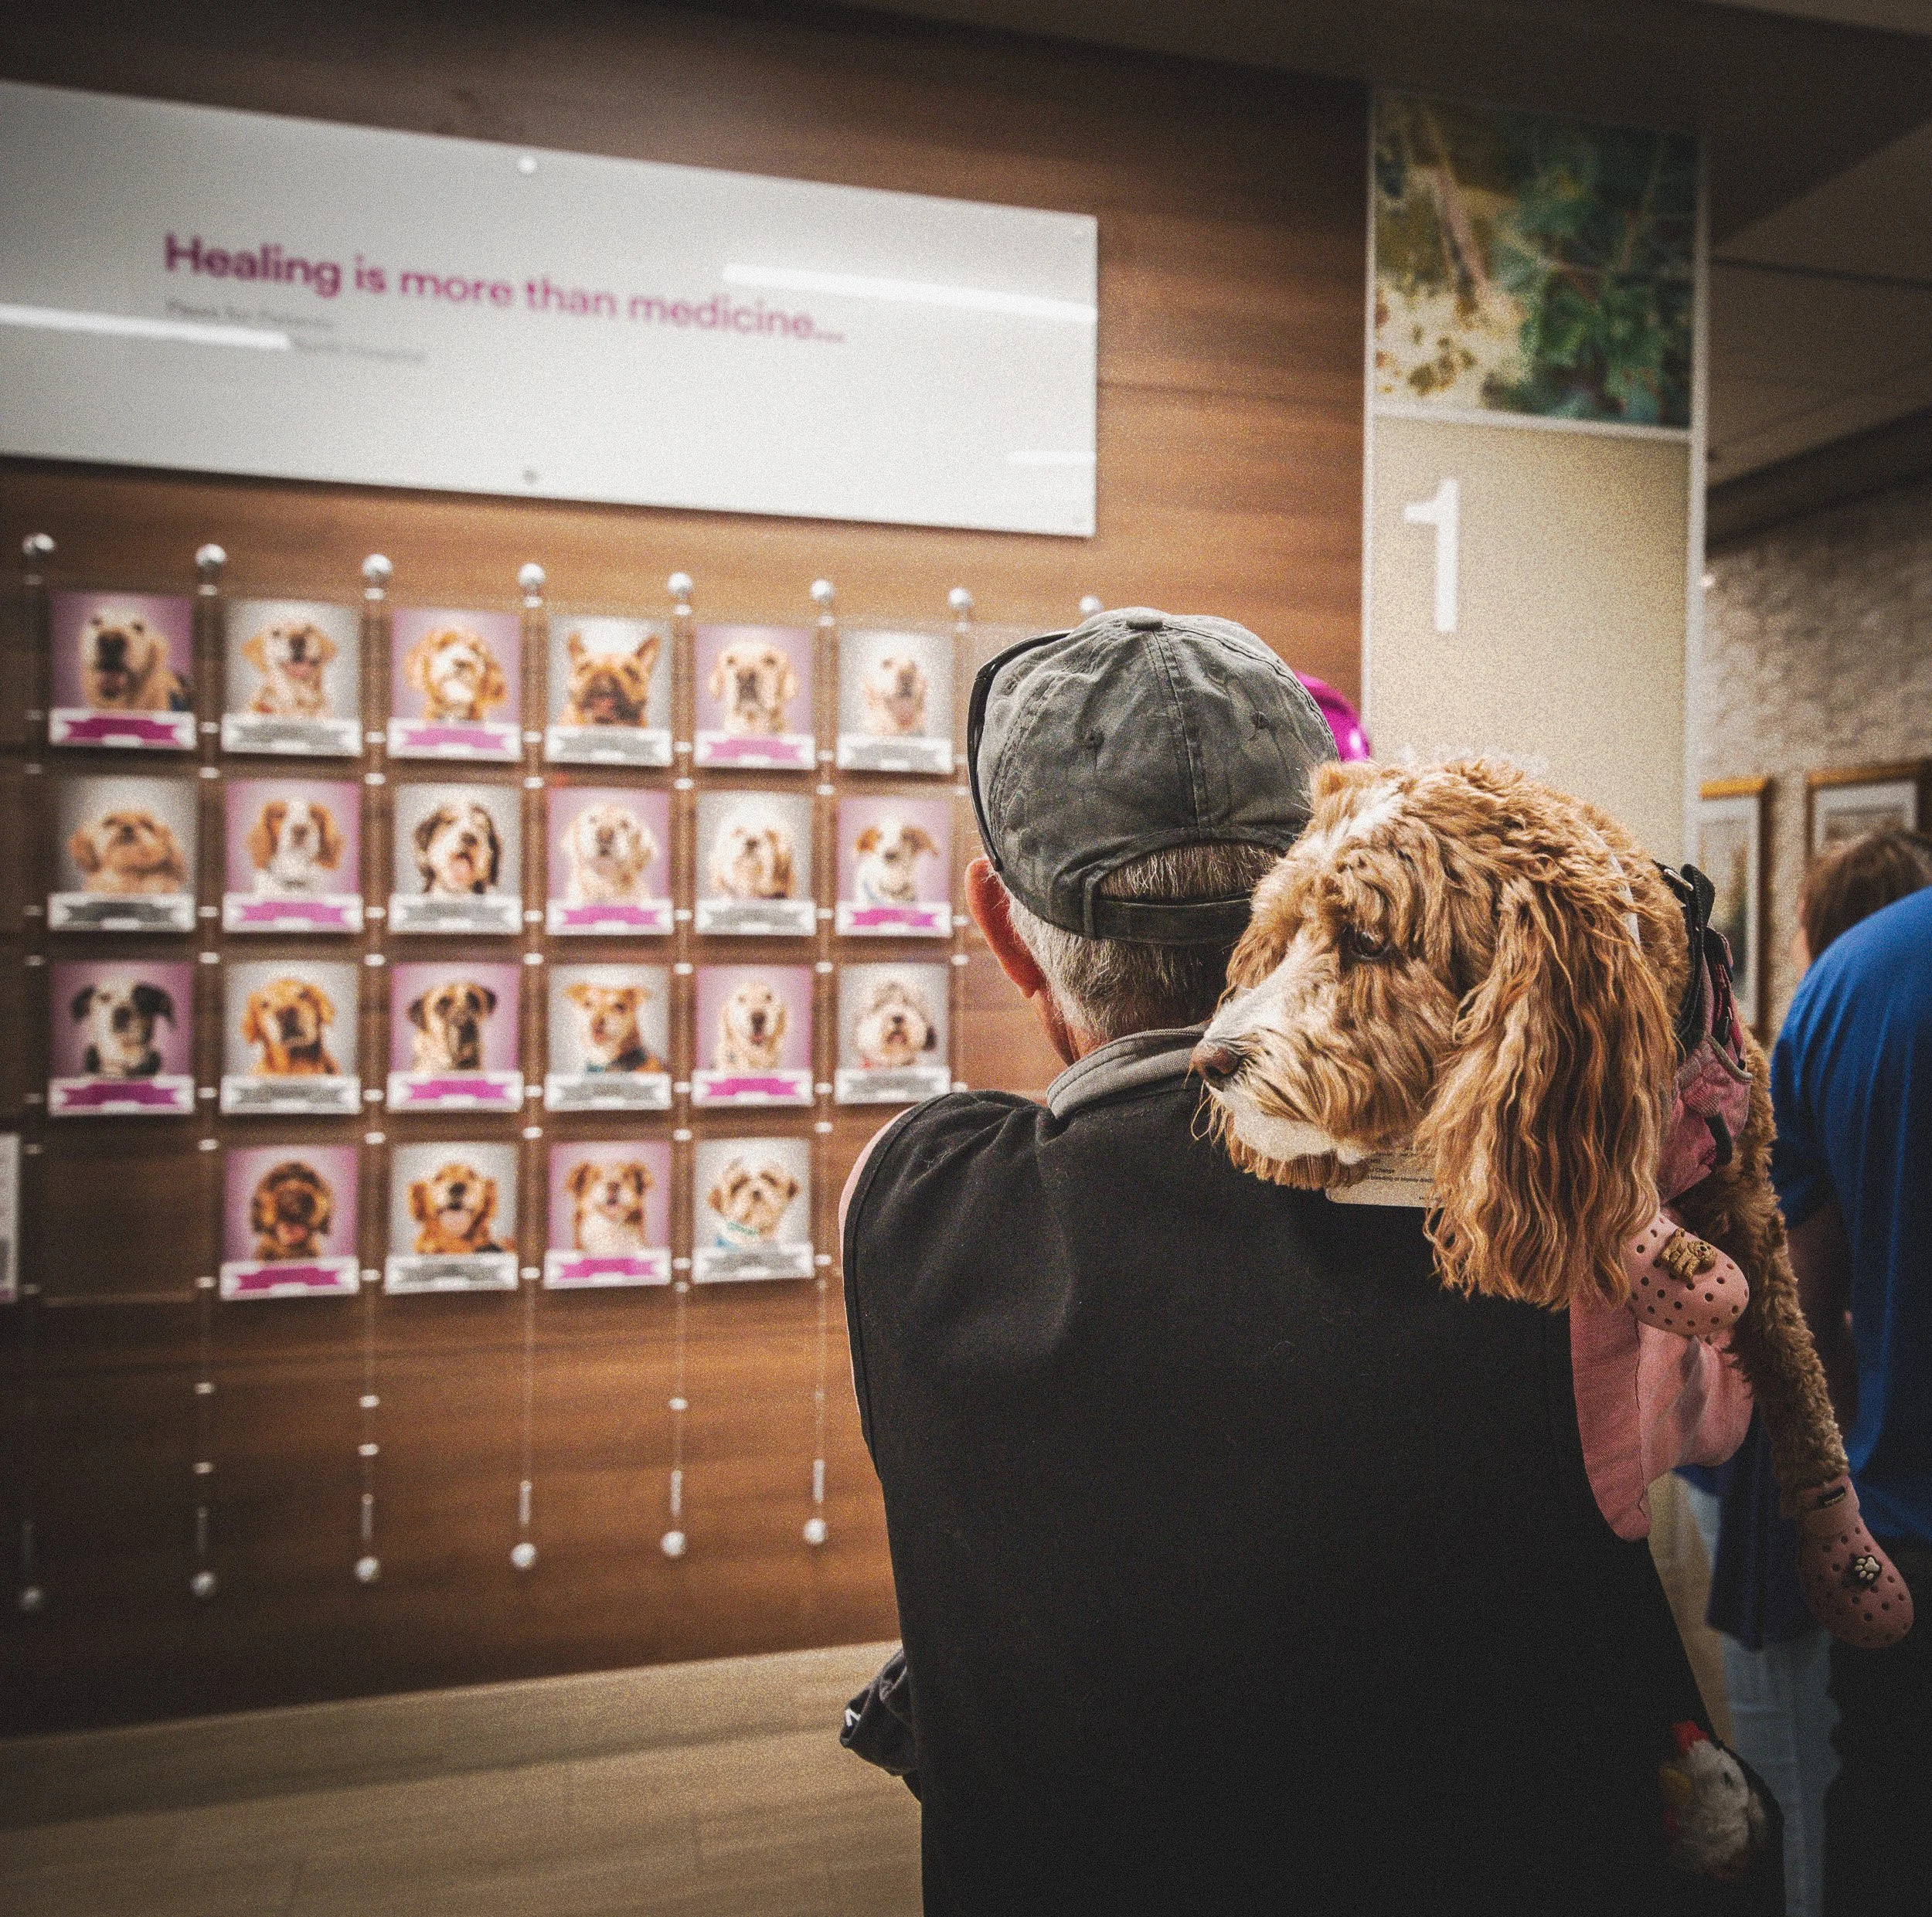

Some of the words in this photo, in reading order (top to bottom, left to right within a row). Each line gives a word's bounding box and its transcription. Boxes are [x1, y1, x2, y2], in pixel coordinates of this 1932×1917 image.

[164, 233, 343, 298] Healing
[354, 253, 387, 294] is
[400, 270, 513, 306] more
[525, 276, 618, 318] than
[1404, 478, 1459, 632] 1
